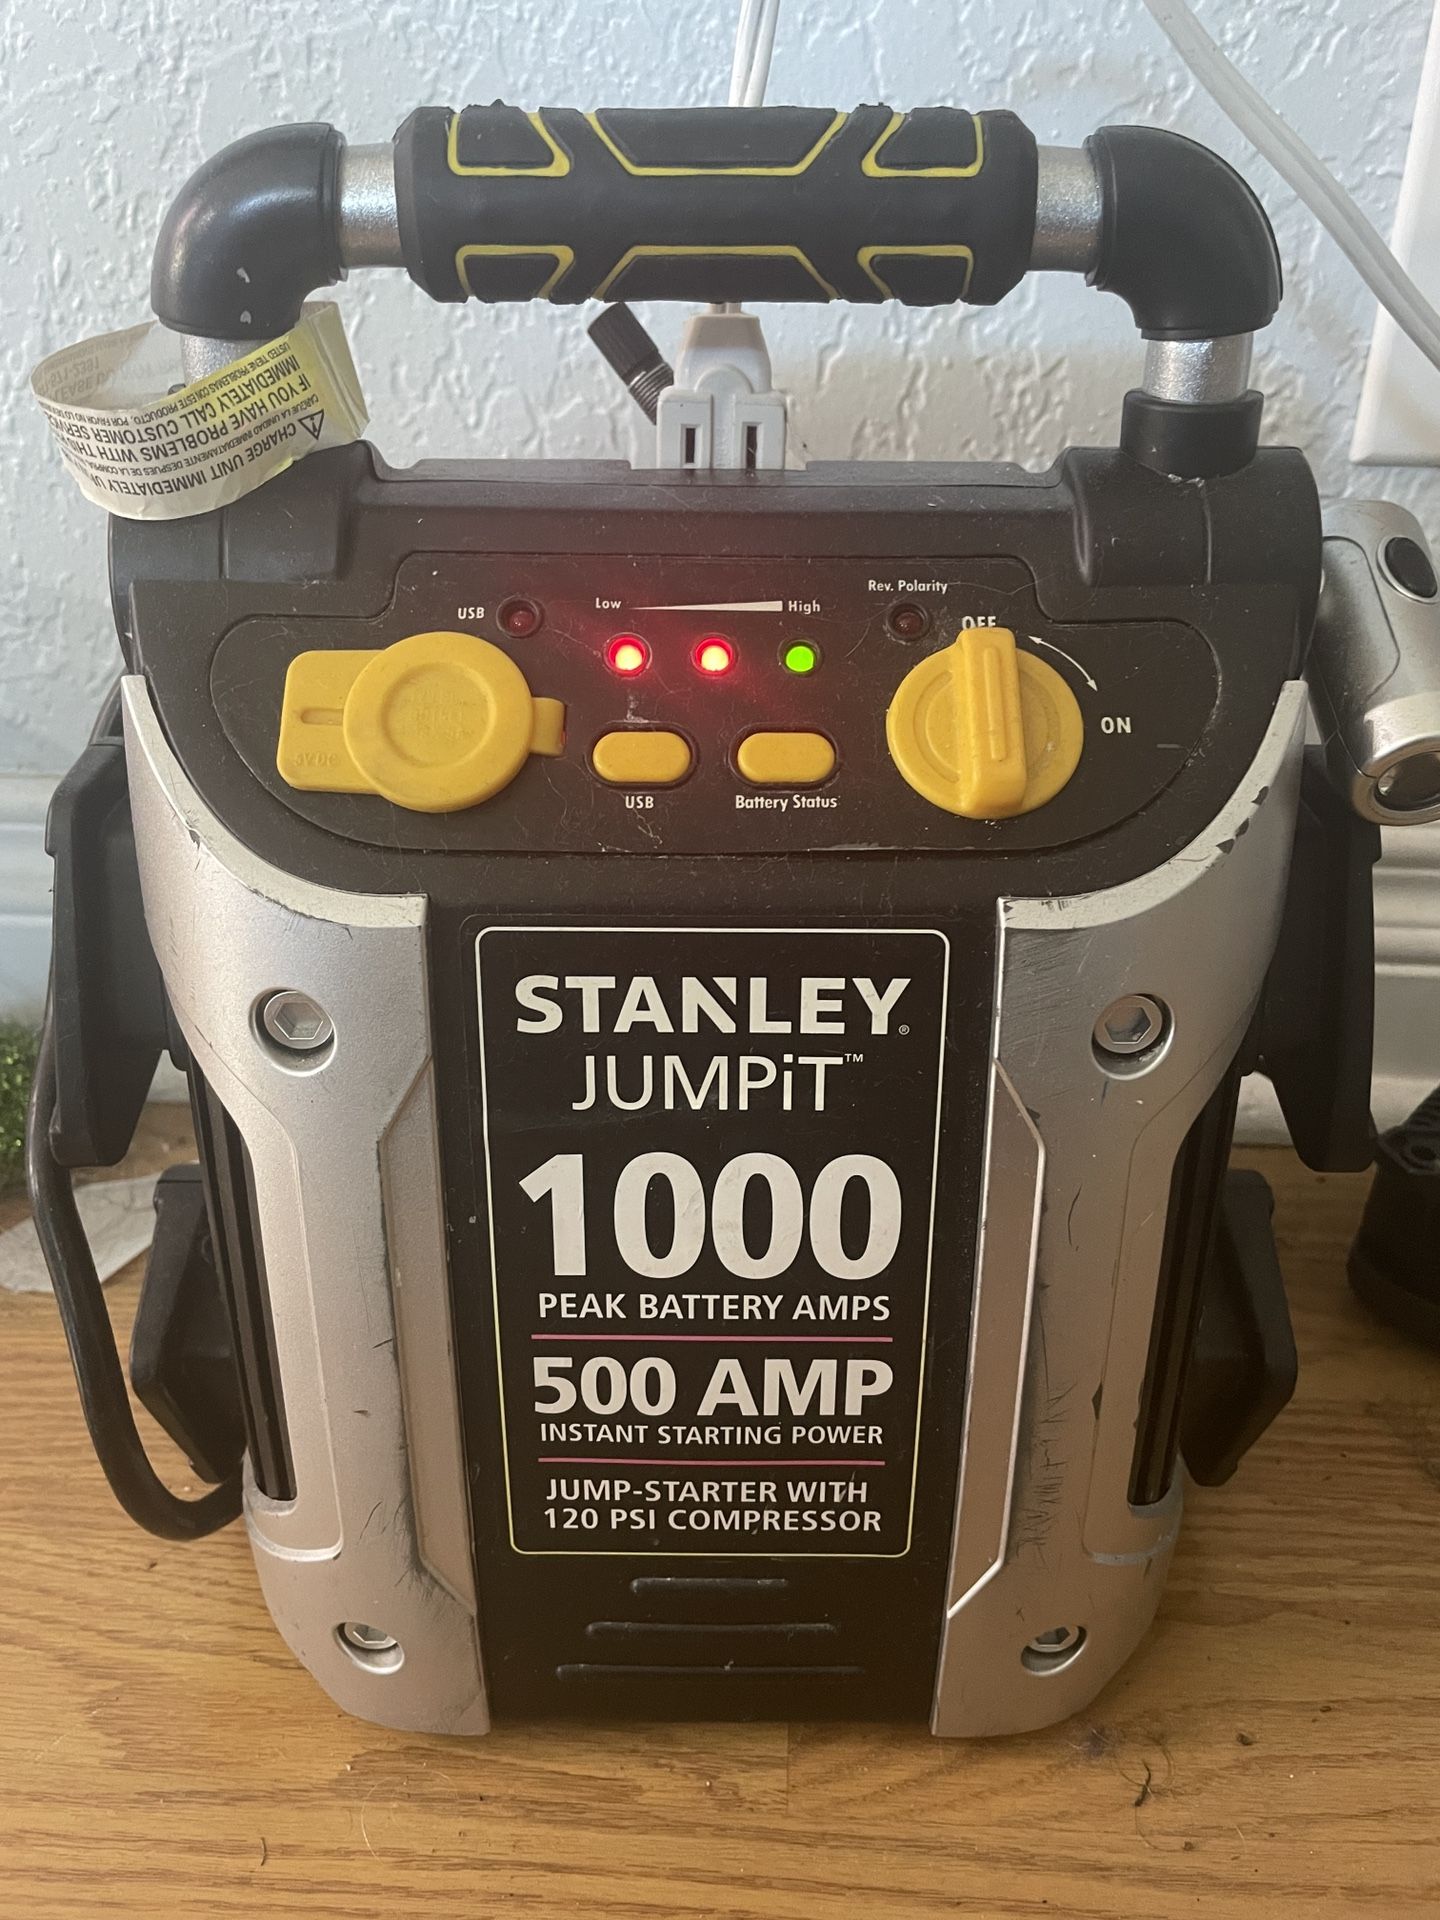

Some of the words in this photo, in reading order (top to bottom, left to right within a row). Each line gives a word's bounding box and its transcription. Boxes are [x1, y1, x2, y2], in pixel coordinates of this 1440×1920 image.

[217, 354, 301, 413] IMMEDIATELY
[268, 382, 300, 408] YOU
[298, 373, 312, 391] IF
[180, 402, 217, 428] CALL
[228, 398, 268, 429] HAVE
[91, 420, 179, 445] CUSTOMER
[140, 420, 229, 462] PROBLEMS
[245, 423, 297, 462] CHARGE
[96, 446, 139, 463] WITH
[210, 455, 245, 481] UNIT
[108, 470, 208, 497] IMMEDIATELY
[867, 580, 894, 592] Rev.
[898, 579, 948, 596] Polarity
[457, 607, 485, 620] USB
[595, 597, 622, 610] Low
[788, 601, 821, 615] High
[961, 616, 997, 630] OFF
[1101, 716, 1132, 734] ON
[625, 796, 655, 809] USB
[735, 794, 789, 812] Battery
[792, 794, 838, 809] Status
[519, 1151, 902, 1281] 1000
[538, 1293, 627, 1320] PEAK
[638, 1293, 784, 1321] BATTERY
[792, 1295, 891, 1322] AMPS
[532, 1356, 677, 1416] 500
[697, 1358, 894, 1417] AMP
[540, 1423, 649, 1444] INSTANT
[657, 1425, 782, 1446] STARTING
[791, 1425, 884, 1446] POWER
[546, 1478, 777, 1504] JUMP-STARTER
[787, 1481, 868, 1503] WITH
[543, 1507, 599, 1530] 120
[610, 1508, 657, 1531] PSI
[667, 1508, 882, 1533] COMPRESSOR
